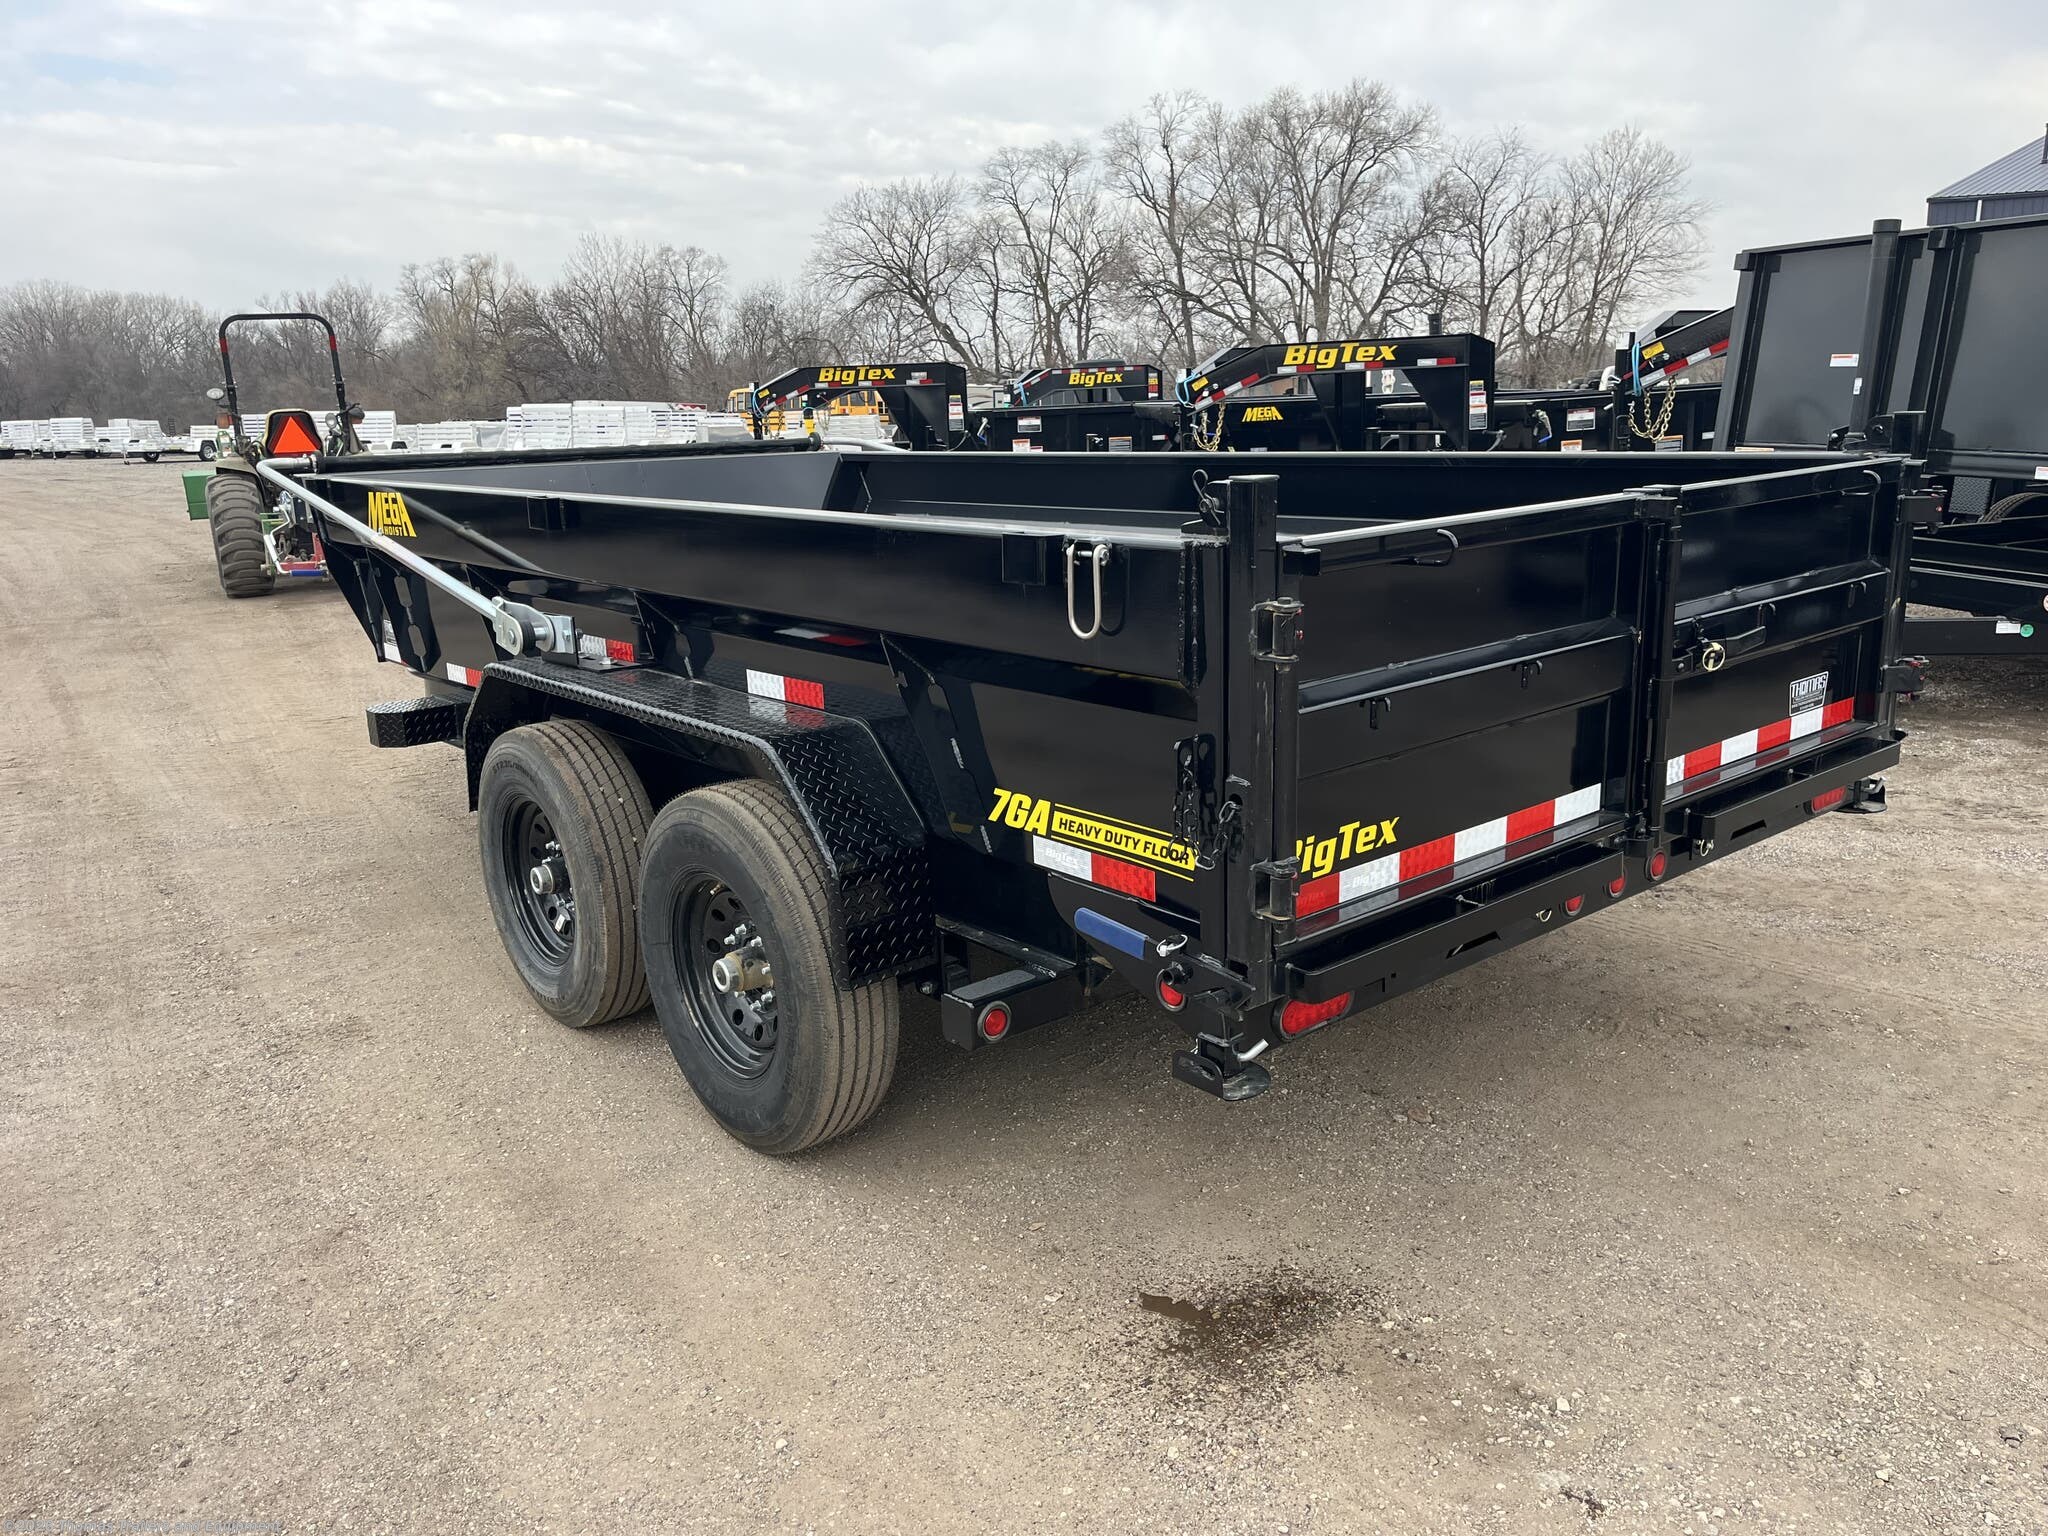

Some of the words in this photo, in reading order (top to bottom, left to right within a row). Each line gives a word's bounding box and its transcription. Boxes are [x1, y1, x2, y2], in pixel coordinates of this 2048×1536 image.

[1283, 342, 1399, 369] BigTex
[818, 366, 896, 385] BigTex
[1068, 371, 1123, 387] BigTex
[1241, 406, 1284, 423] MEGA
[368, 491, 417, 538] MEGA
[1791, 675, 1826, 698] THOMAS
[987, 787, 1052, 836] 7GA
[1058, 817, 1102, 840] HEAVY
[1104, 830, 1141, 850] DUTY
[1143, 841, 1190, 866] FLOOR
